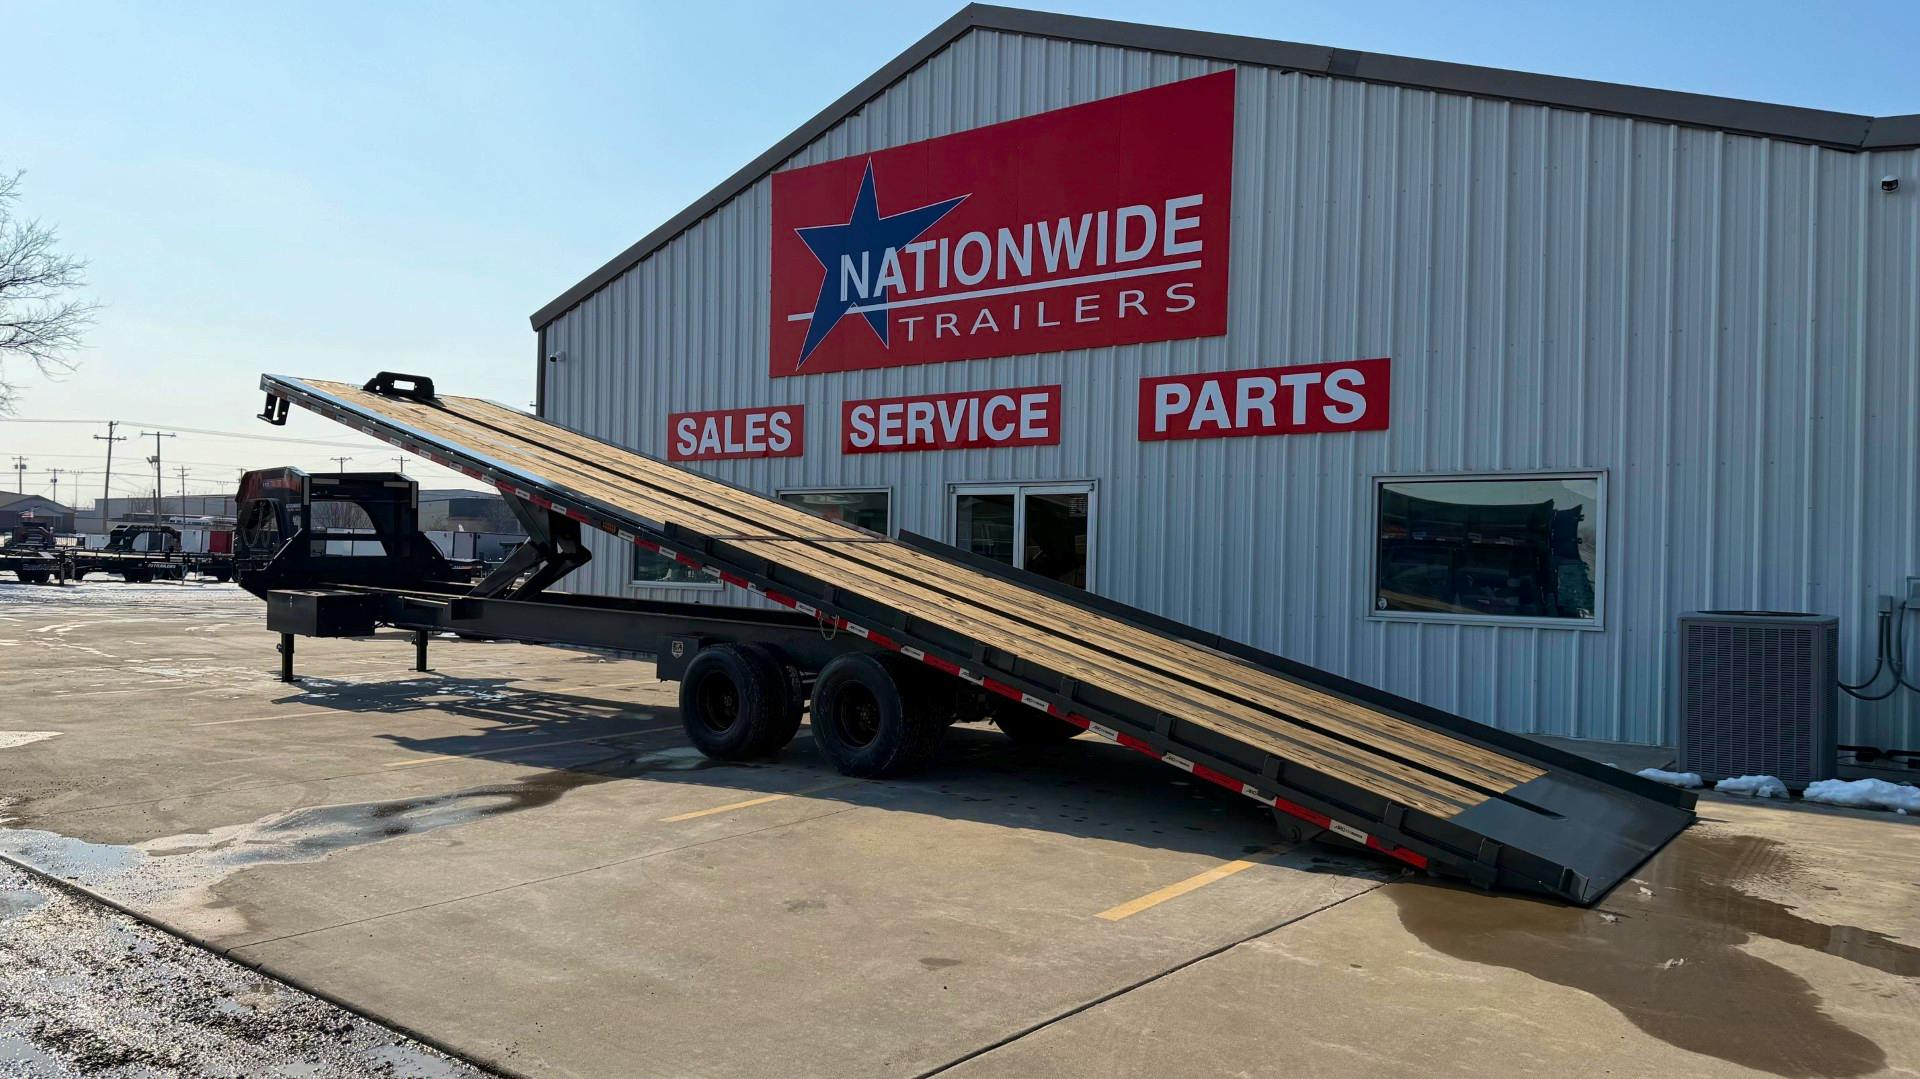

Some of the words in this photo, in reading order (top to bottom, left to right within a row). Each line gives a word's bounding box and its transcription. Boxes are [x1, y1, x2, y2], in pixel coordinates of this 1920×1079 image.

[840, 193, 1203, 302] NATIONWIDE
[898, 282, 1197, 342] TRAILERS
[849, 392, 1049, 448] SERVICE
[1155, 368, 1368, 433] PARTS
[676, 411, 792, 456] SALES
